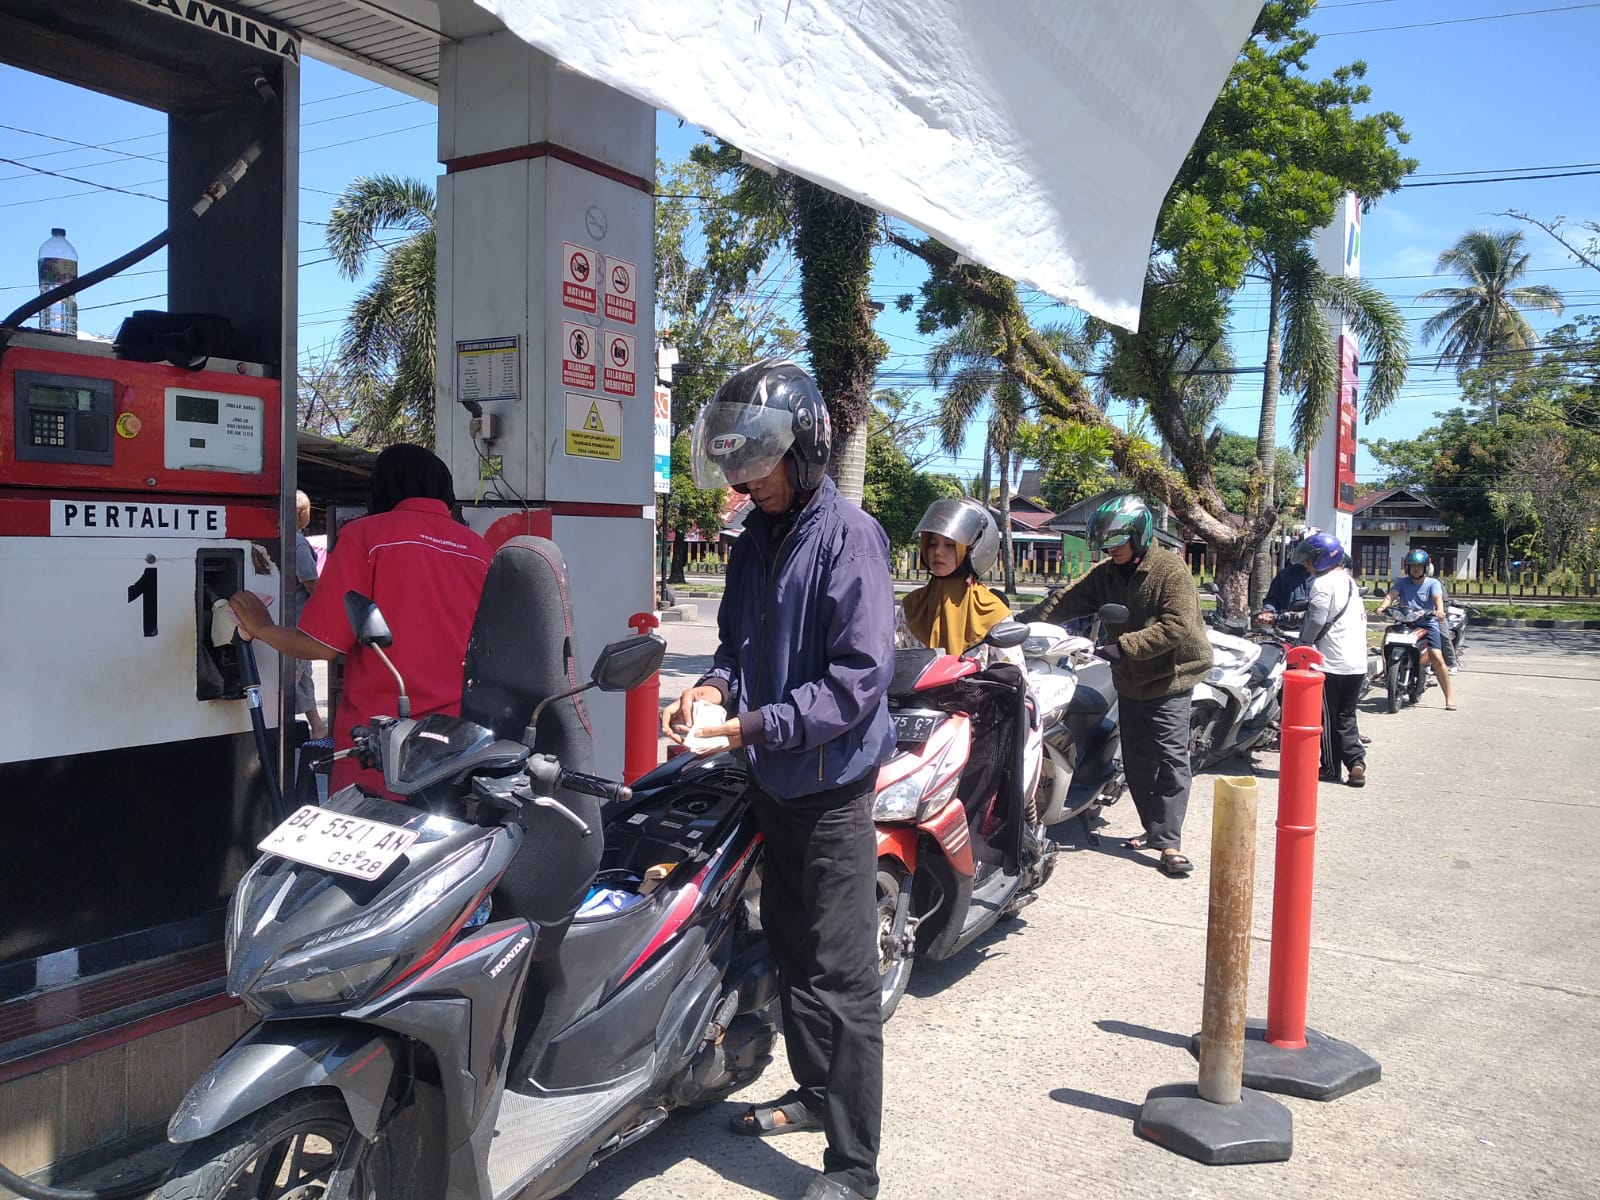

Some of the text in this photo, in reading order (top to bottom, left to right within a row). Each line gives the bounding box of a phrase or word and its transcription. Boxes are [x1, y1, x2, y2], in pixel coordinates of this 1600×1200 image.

[142, 0, 299, 64] AMINA
[567, 285, 592, 300] MATIKAN
[607, 305, 633, 321] MEROKOK
[567, 362, 591, 373] DILARANG
[606, 369, 632, 382] DILARANG
[605, 379, 634, 393] MEMOTRET
[713, 438, 737, 449] GM
[64, 504, 218, 531] PERTALITE
[127, 567, 159, 637] 1
[893, 715, 908, 727] 75
[418, 731, 449, 744] HONDA
[288, 808, 321, 829] BA
[373, 830, 411, 852] AN
[489, 936, 531, 979] HONDA
